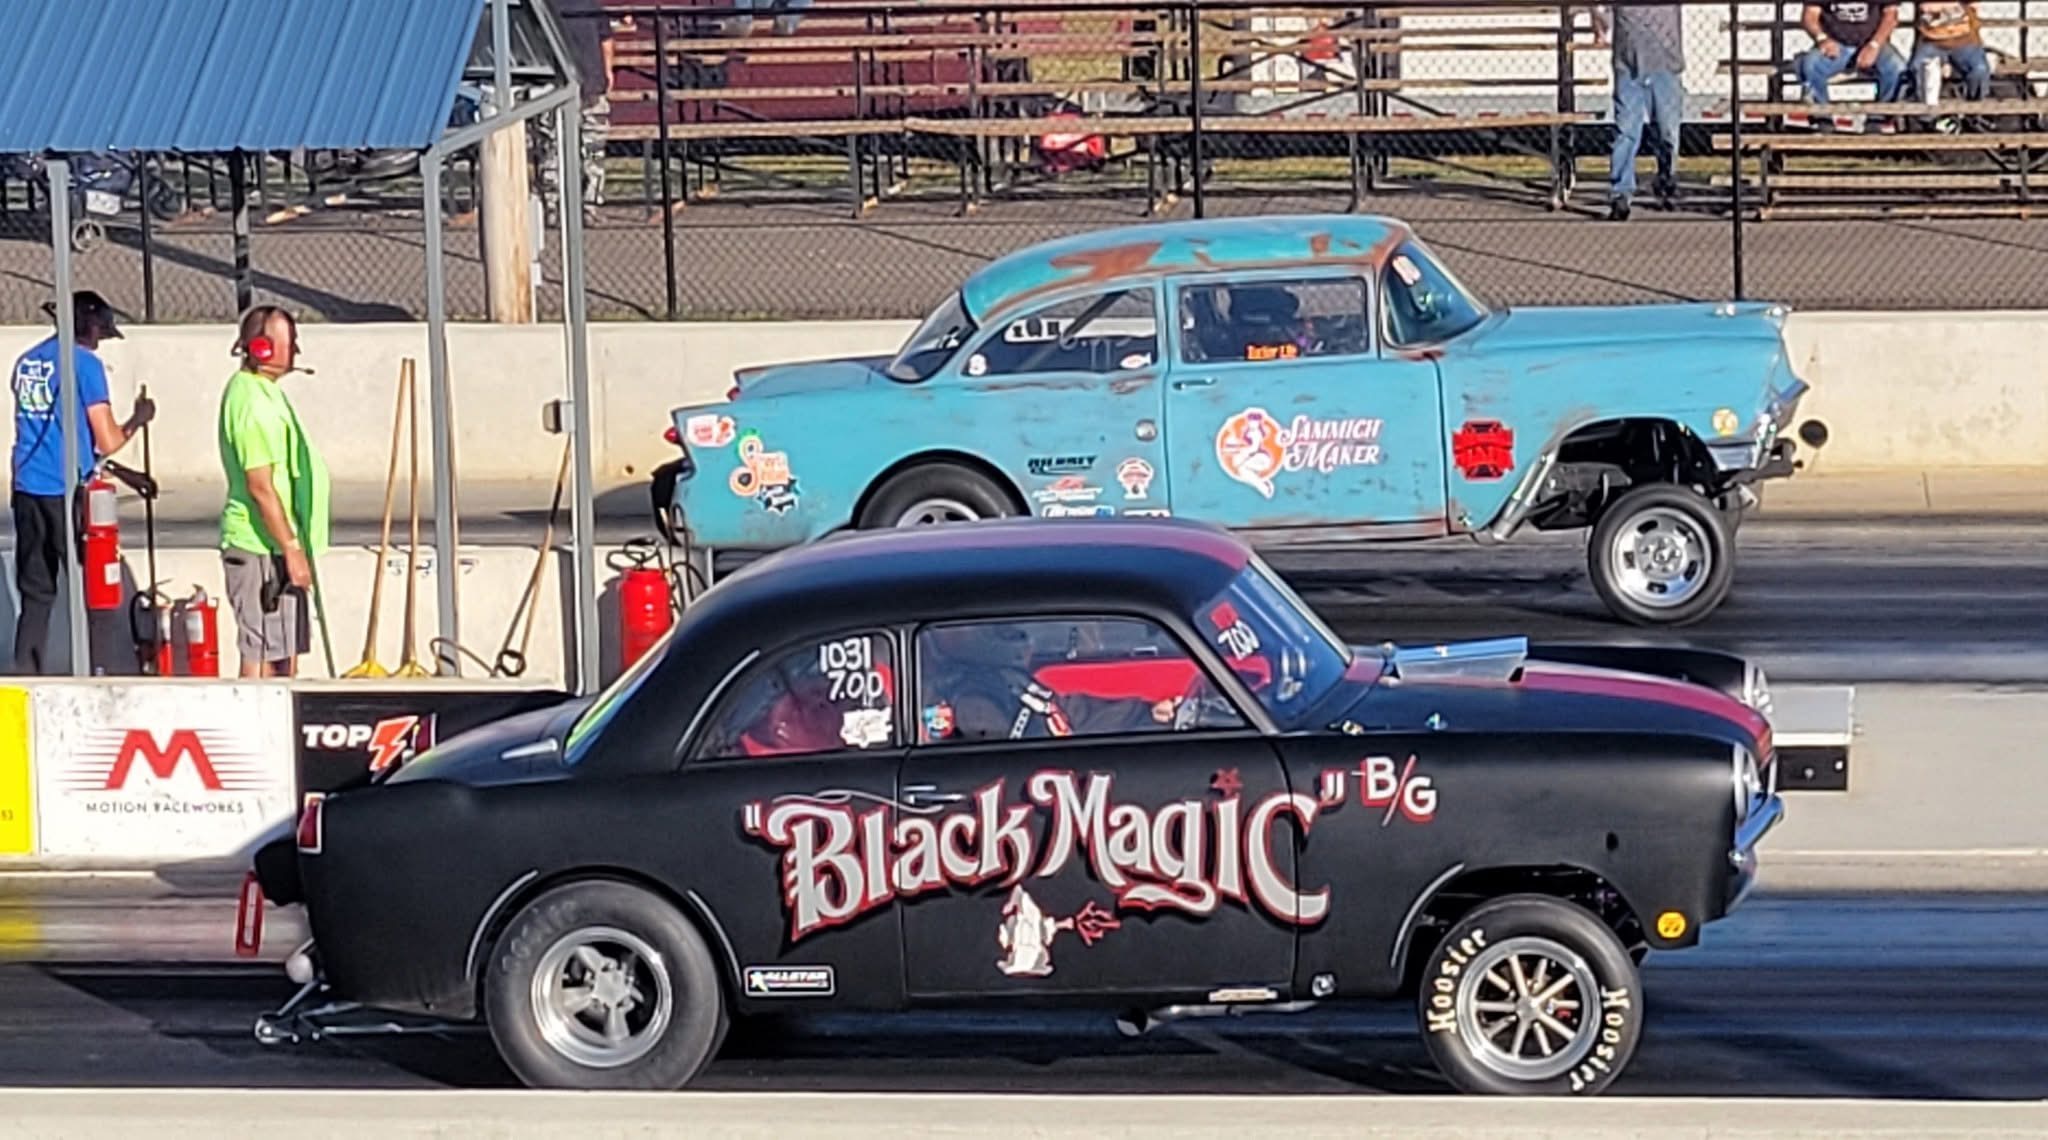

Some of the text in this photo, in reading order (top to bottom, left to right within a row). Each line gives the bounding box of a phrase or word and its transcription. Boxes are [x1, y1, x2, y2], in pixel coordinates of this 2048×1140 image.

[1275, 415, 1382, 447] SAMMICH
[1284, 441, 1380, 473] MAKER
[820, 636, 872, 672] 1031
[827, 669, 884, 701] 7.00
[302, 724, 373, 748] TOP
[86, 801, 244, 813] MOTION RACEWORKS
[1426, 928, 1487, 1034] Hoosier
[1568, 985, 1632, 1092] Hoosier
